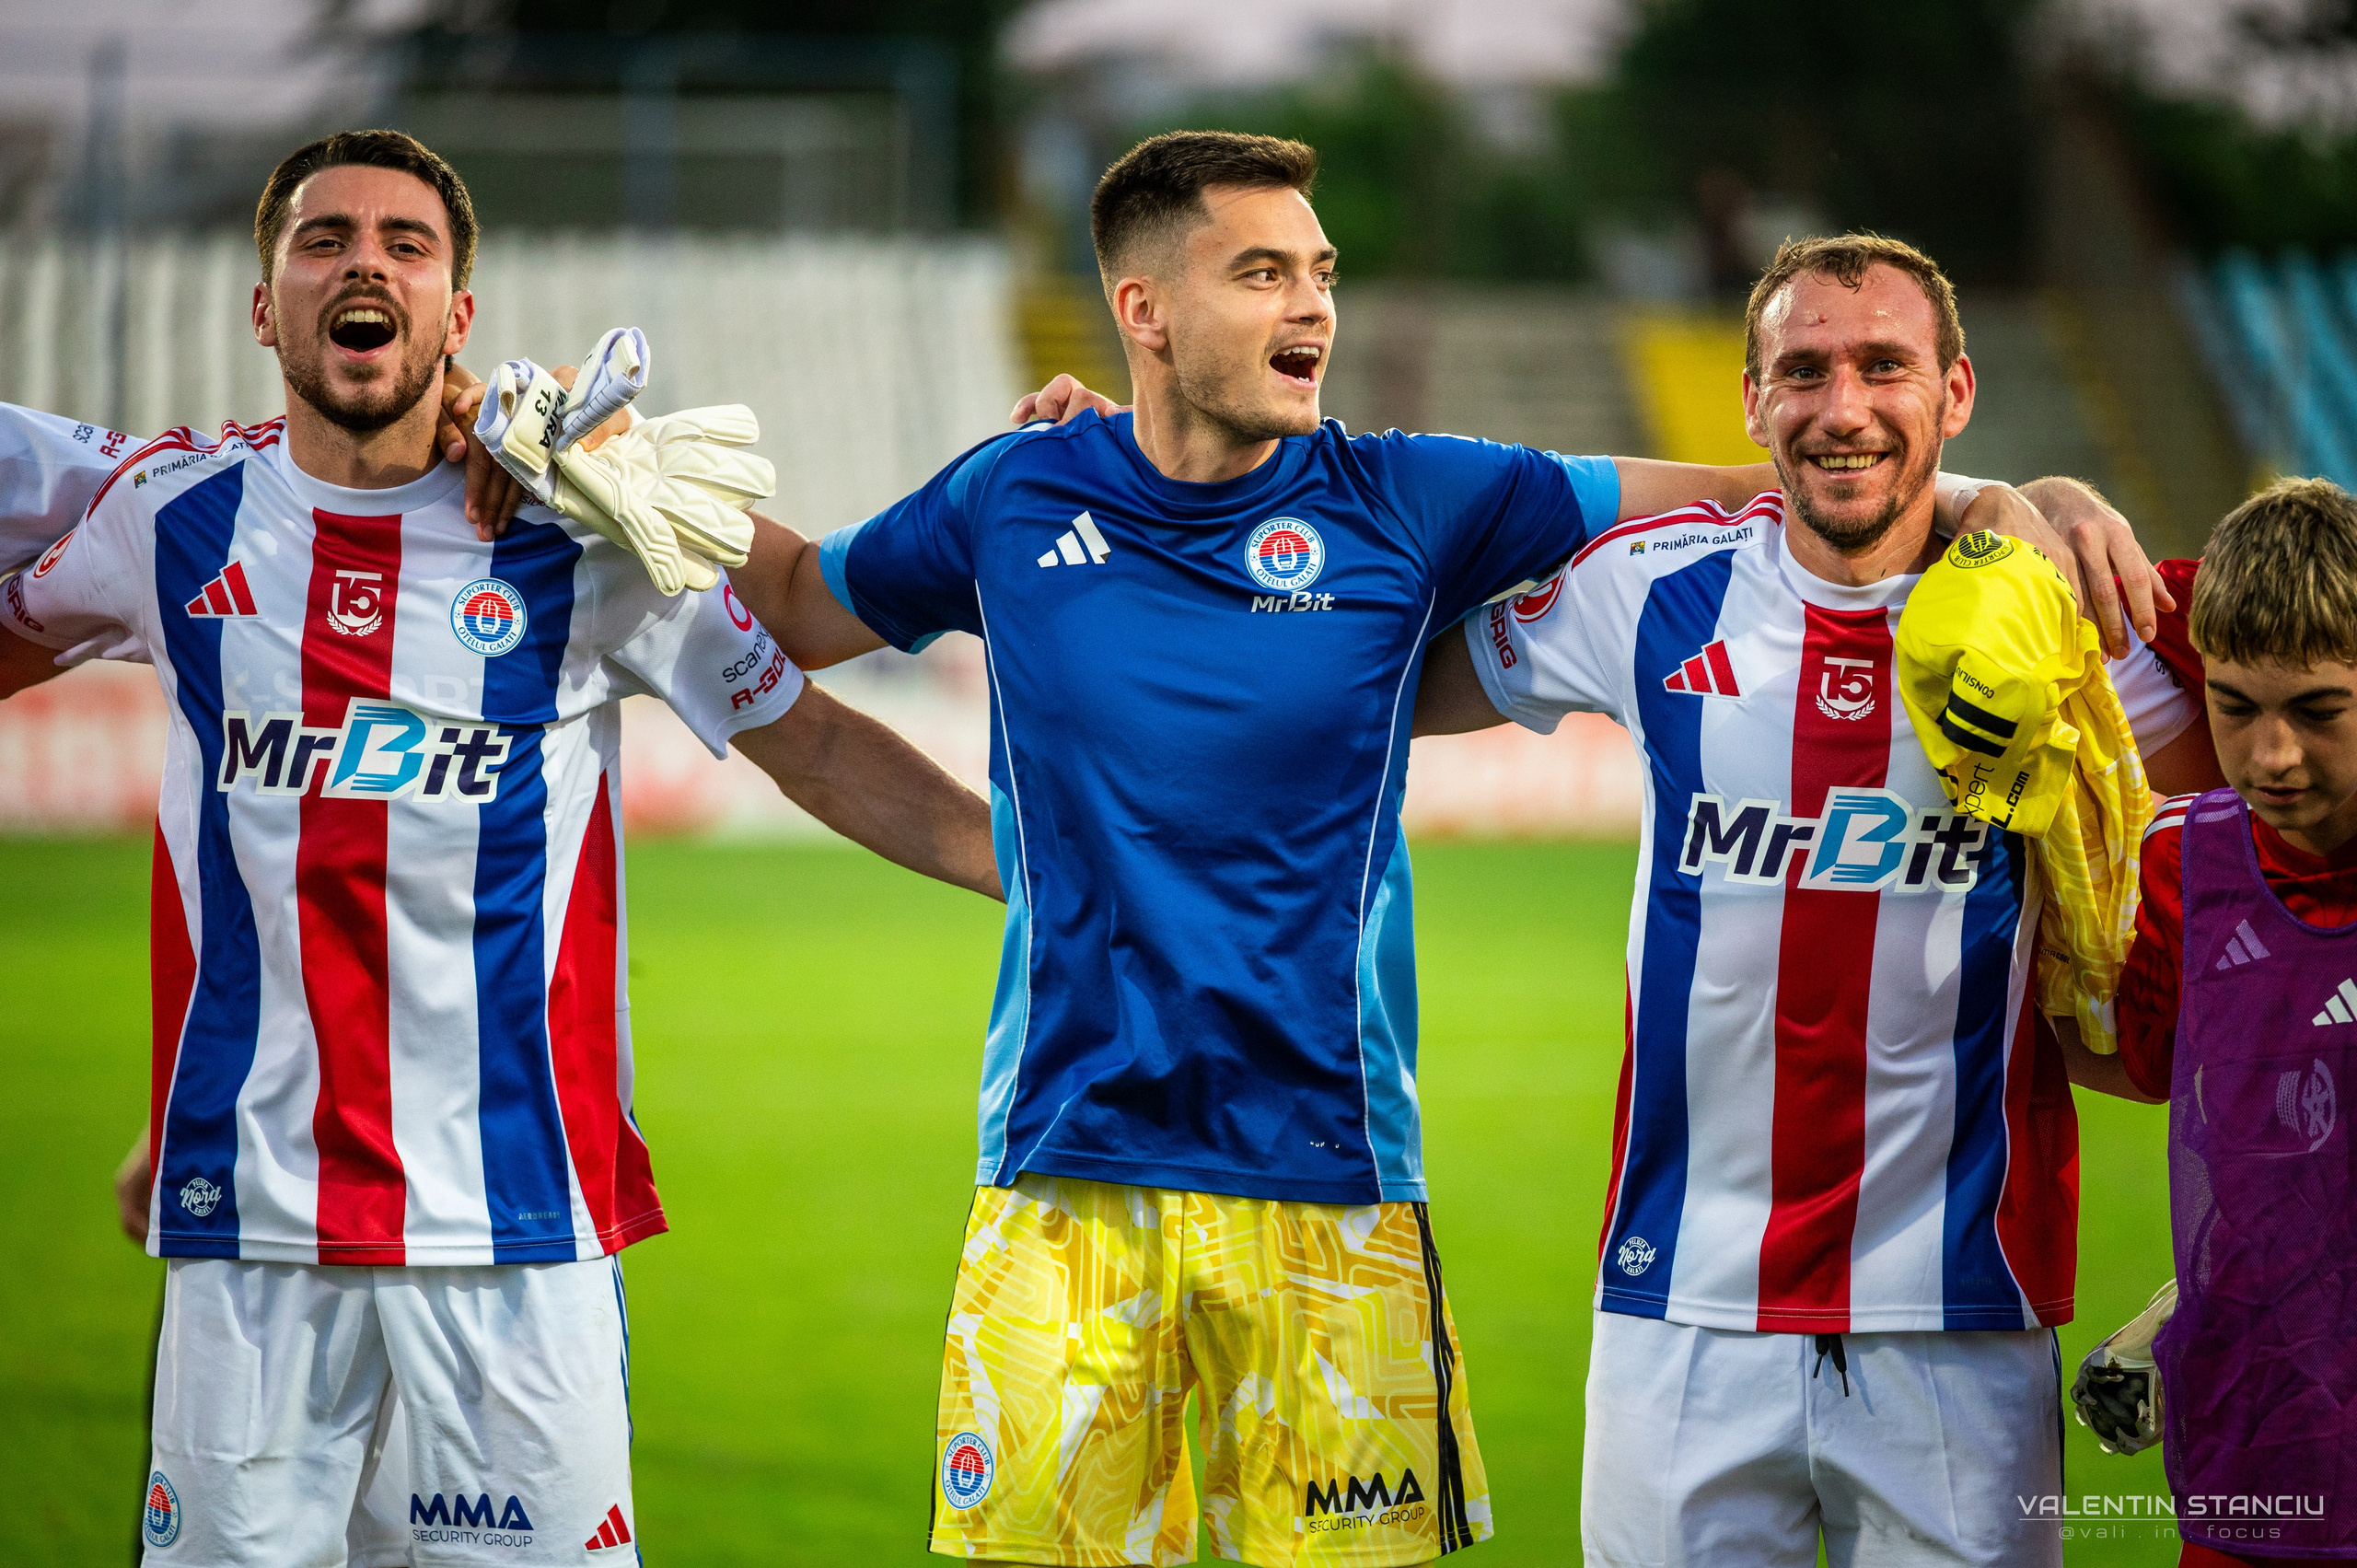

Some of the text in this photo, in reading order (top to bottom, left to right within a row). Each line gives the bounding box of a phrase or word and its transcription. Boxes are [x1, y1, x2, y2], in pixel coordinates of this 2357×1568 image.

[535, 389, 551, 416] 13
[153, 454, 206, 477] PRIMĂRIA
[1252, 522, 1315, 548] SUPORTER CLUB
[1653, 527, 1753, 551] PRIMĂRIA GALAȚI
[1955, 556, 1972, 566] CLUB
[1257, 563, 1317, 587] OTELUL GALATI
[459, 584, 520, 611] SUPORTER CLUB
[1250, 591, 1336, 613] MrBit
[458, 627, 517, 652] OTELUL GALATI
[221, 702, 505, 797] MrBit
[1684, 792, 1982, 887] MrBit
[180, 1186, 222, 1208] Nord
[1618, 1245, 1656, 1267] Nord
[947, 1436, 990, 1465] SUPORTER CLUB
[963, 1486, 985, 1504] GALATI
[1306, 1468, 1425, 1516] MMA
[410, 1493, 534, 1530] MMA
[1309, 1506, 1425, 1534] SECURITY GROUP
[412, 1528, 533, 1548] SECURITY GROUP
